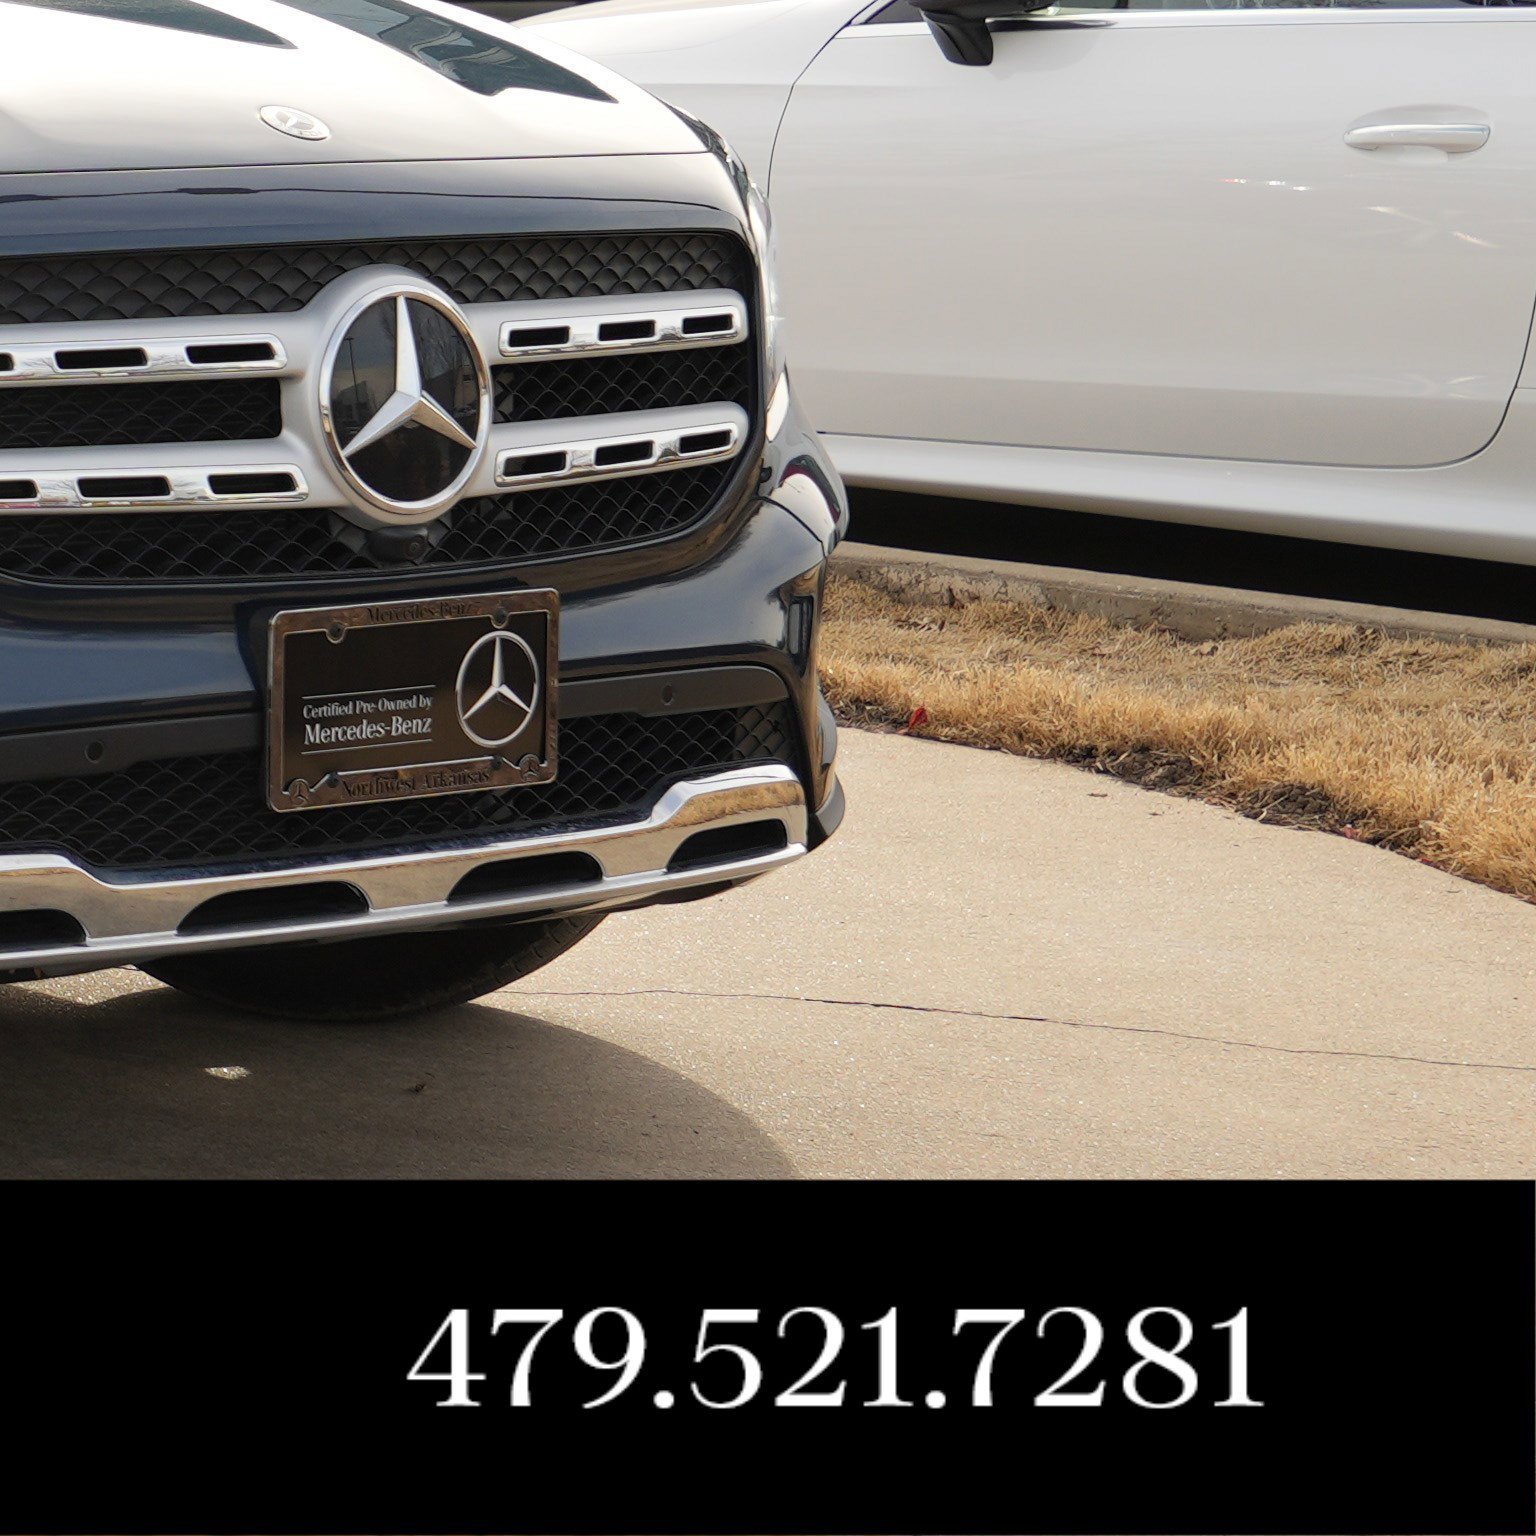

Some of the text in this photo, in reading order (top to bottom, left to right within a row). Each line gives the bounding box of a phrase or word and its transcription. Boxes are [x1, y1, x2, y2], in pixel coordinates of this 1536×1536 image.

[302, 694, 434, 719] Certified Pre-Owned by
[303, 715, 433, 745] Mercedes-Benz
[342, 767, 493, 798] Northwest Arkansas
